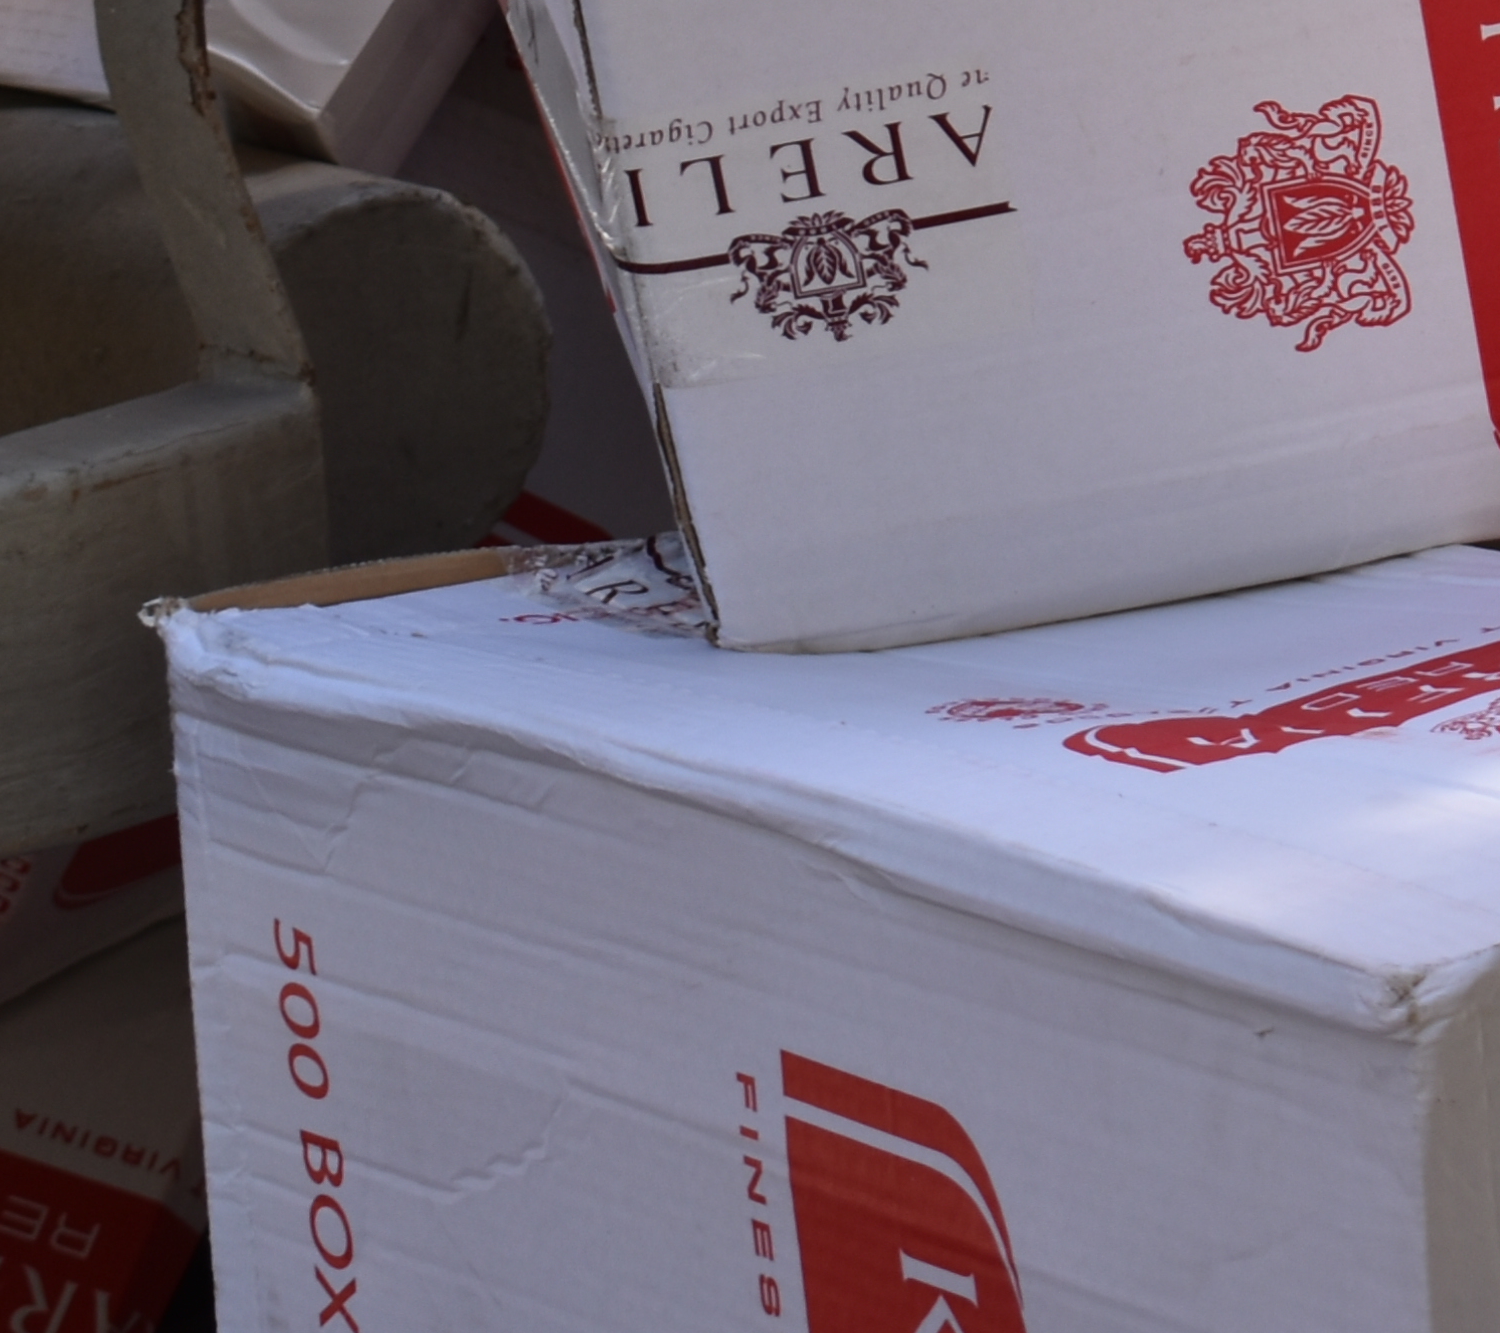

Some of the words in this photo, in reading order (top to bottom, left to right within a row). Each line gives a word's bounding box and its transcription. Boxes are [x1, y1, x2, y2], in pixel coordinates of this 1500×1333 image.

[736, 98, 825, 136] Export
[837, 72, 950, 115] Quality
[624, 103, 994, 229] ARELI
[272, 916, 331, 1101] 500
